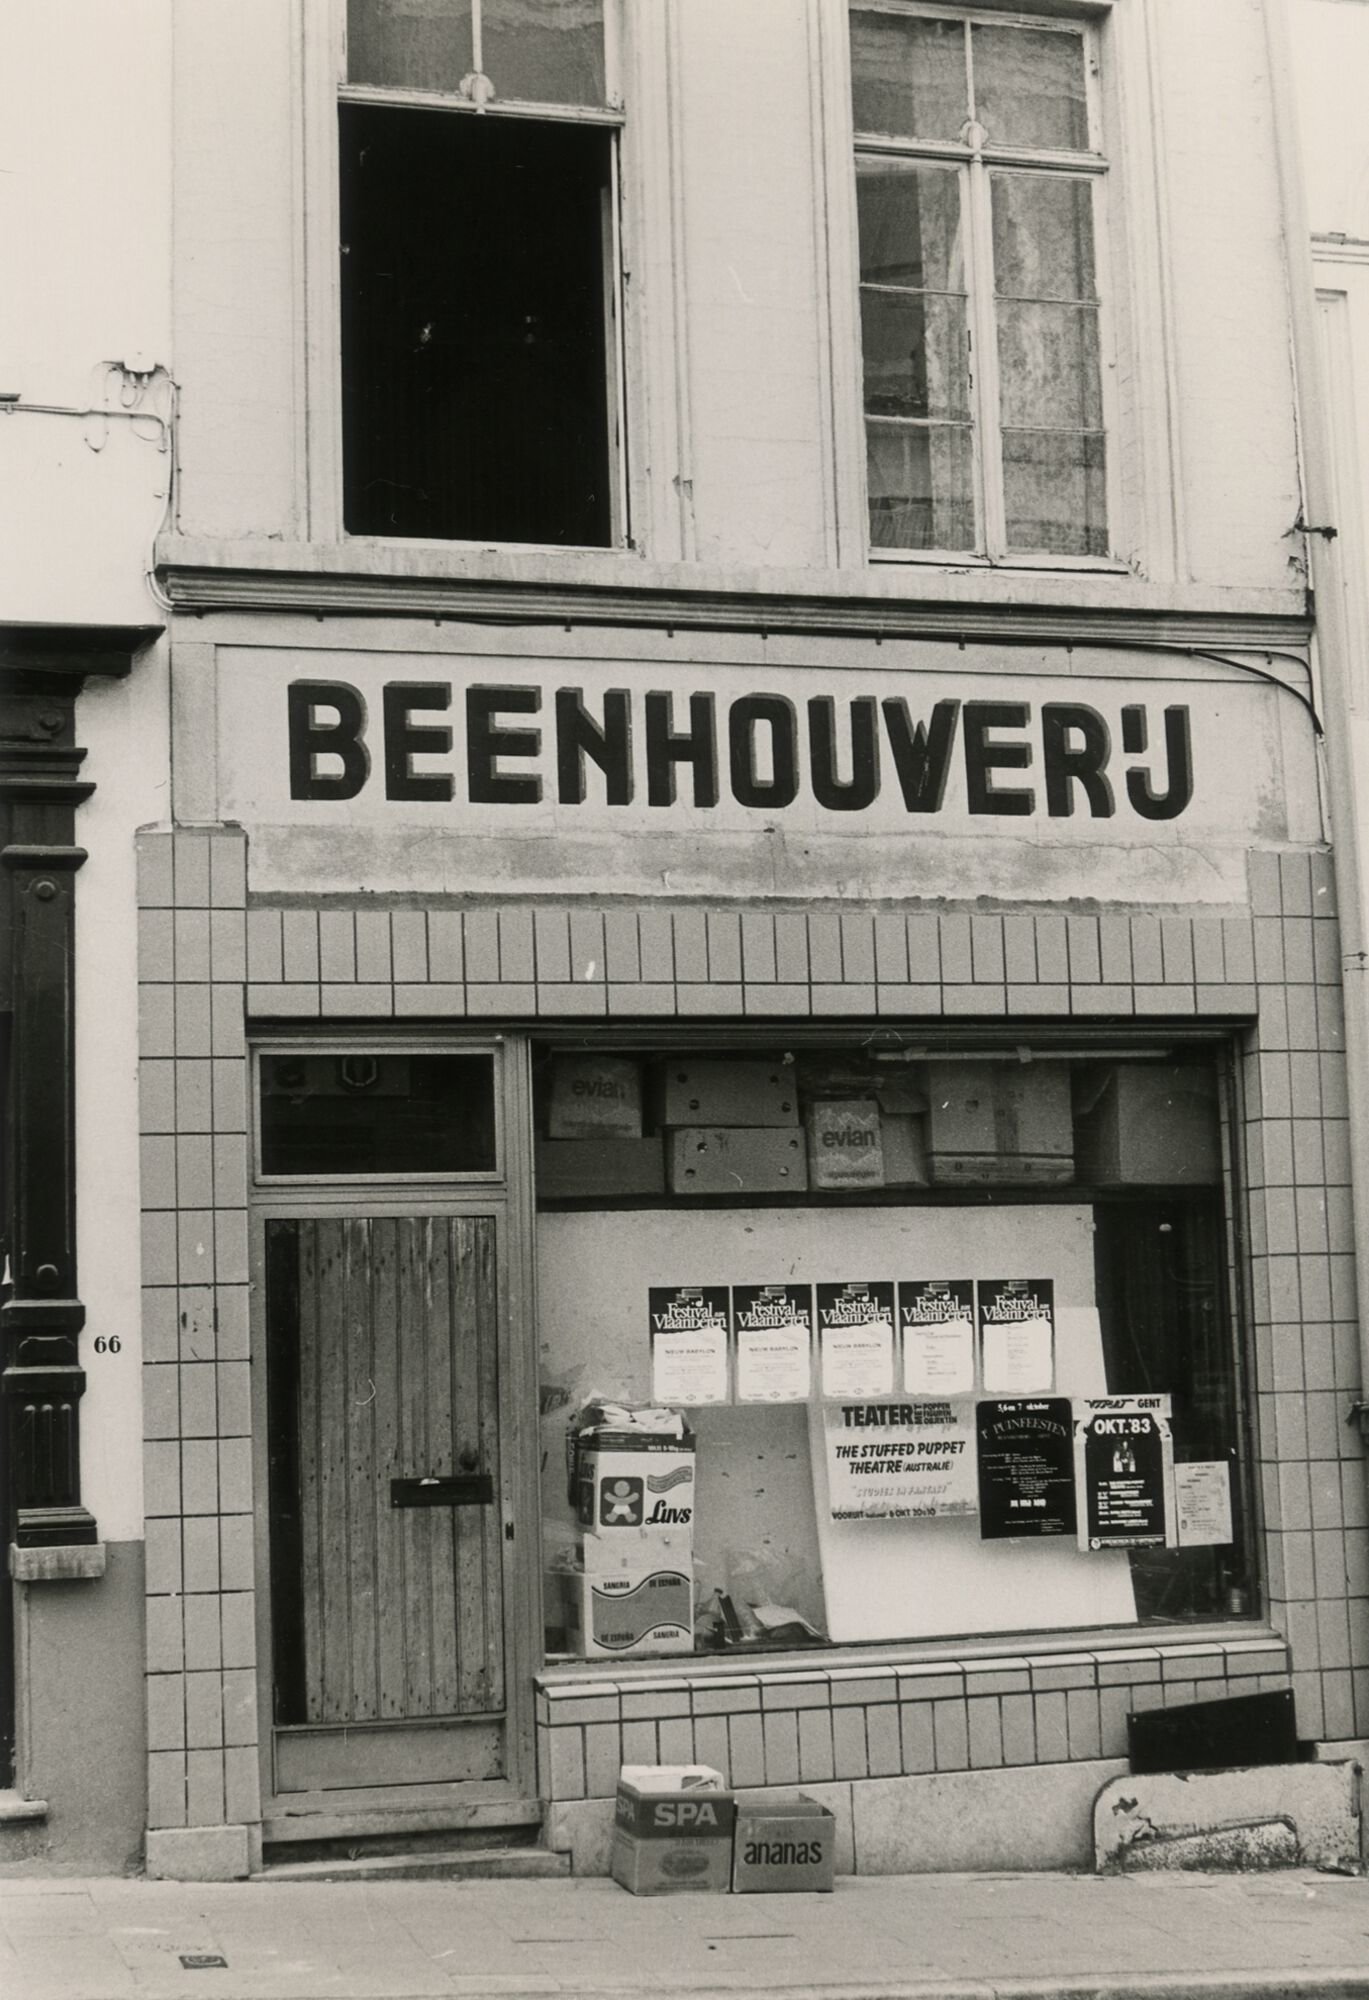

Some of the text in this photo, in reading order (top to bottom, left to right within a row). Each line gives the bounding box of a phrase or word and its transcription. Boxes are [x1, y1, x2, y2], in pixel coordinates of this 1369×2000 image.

[288, 679, 1194, 821] BEENHOUWERIJ
[822, 1125, 876, 1147] evian
[667, 1302, 713, 1319] Festival
[751, 1300, 796, 1317] Festival
[834, 1297, 878, 1314] Festival
[916, 1296, 959, 1313] Festival
[995, 1295, 1038, 1312] Festival
[94, 1335, 121, 1353] 66
[1138, 1398, 1161, 1408] GENT
[842, 1404, 914, 1426] TEATER
[835, 1441, 966, 1458] THE STUFFED PUPPET
[849, 1460, 902, 1474] THEATRE
[645, 1499, 692, 1525] Luvs
[603, 1581, 630, 1590] SANGRIA
[653, 1631, 679, 1640] SANGRIA
[654, 1803, 719, 1826] SPA
[744, 1842, 822, 1865] ananas
